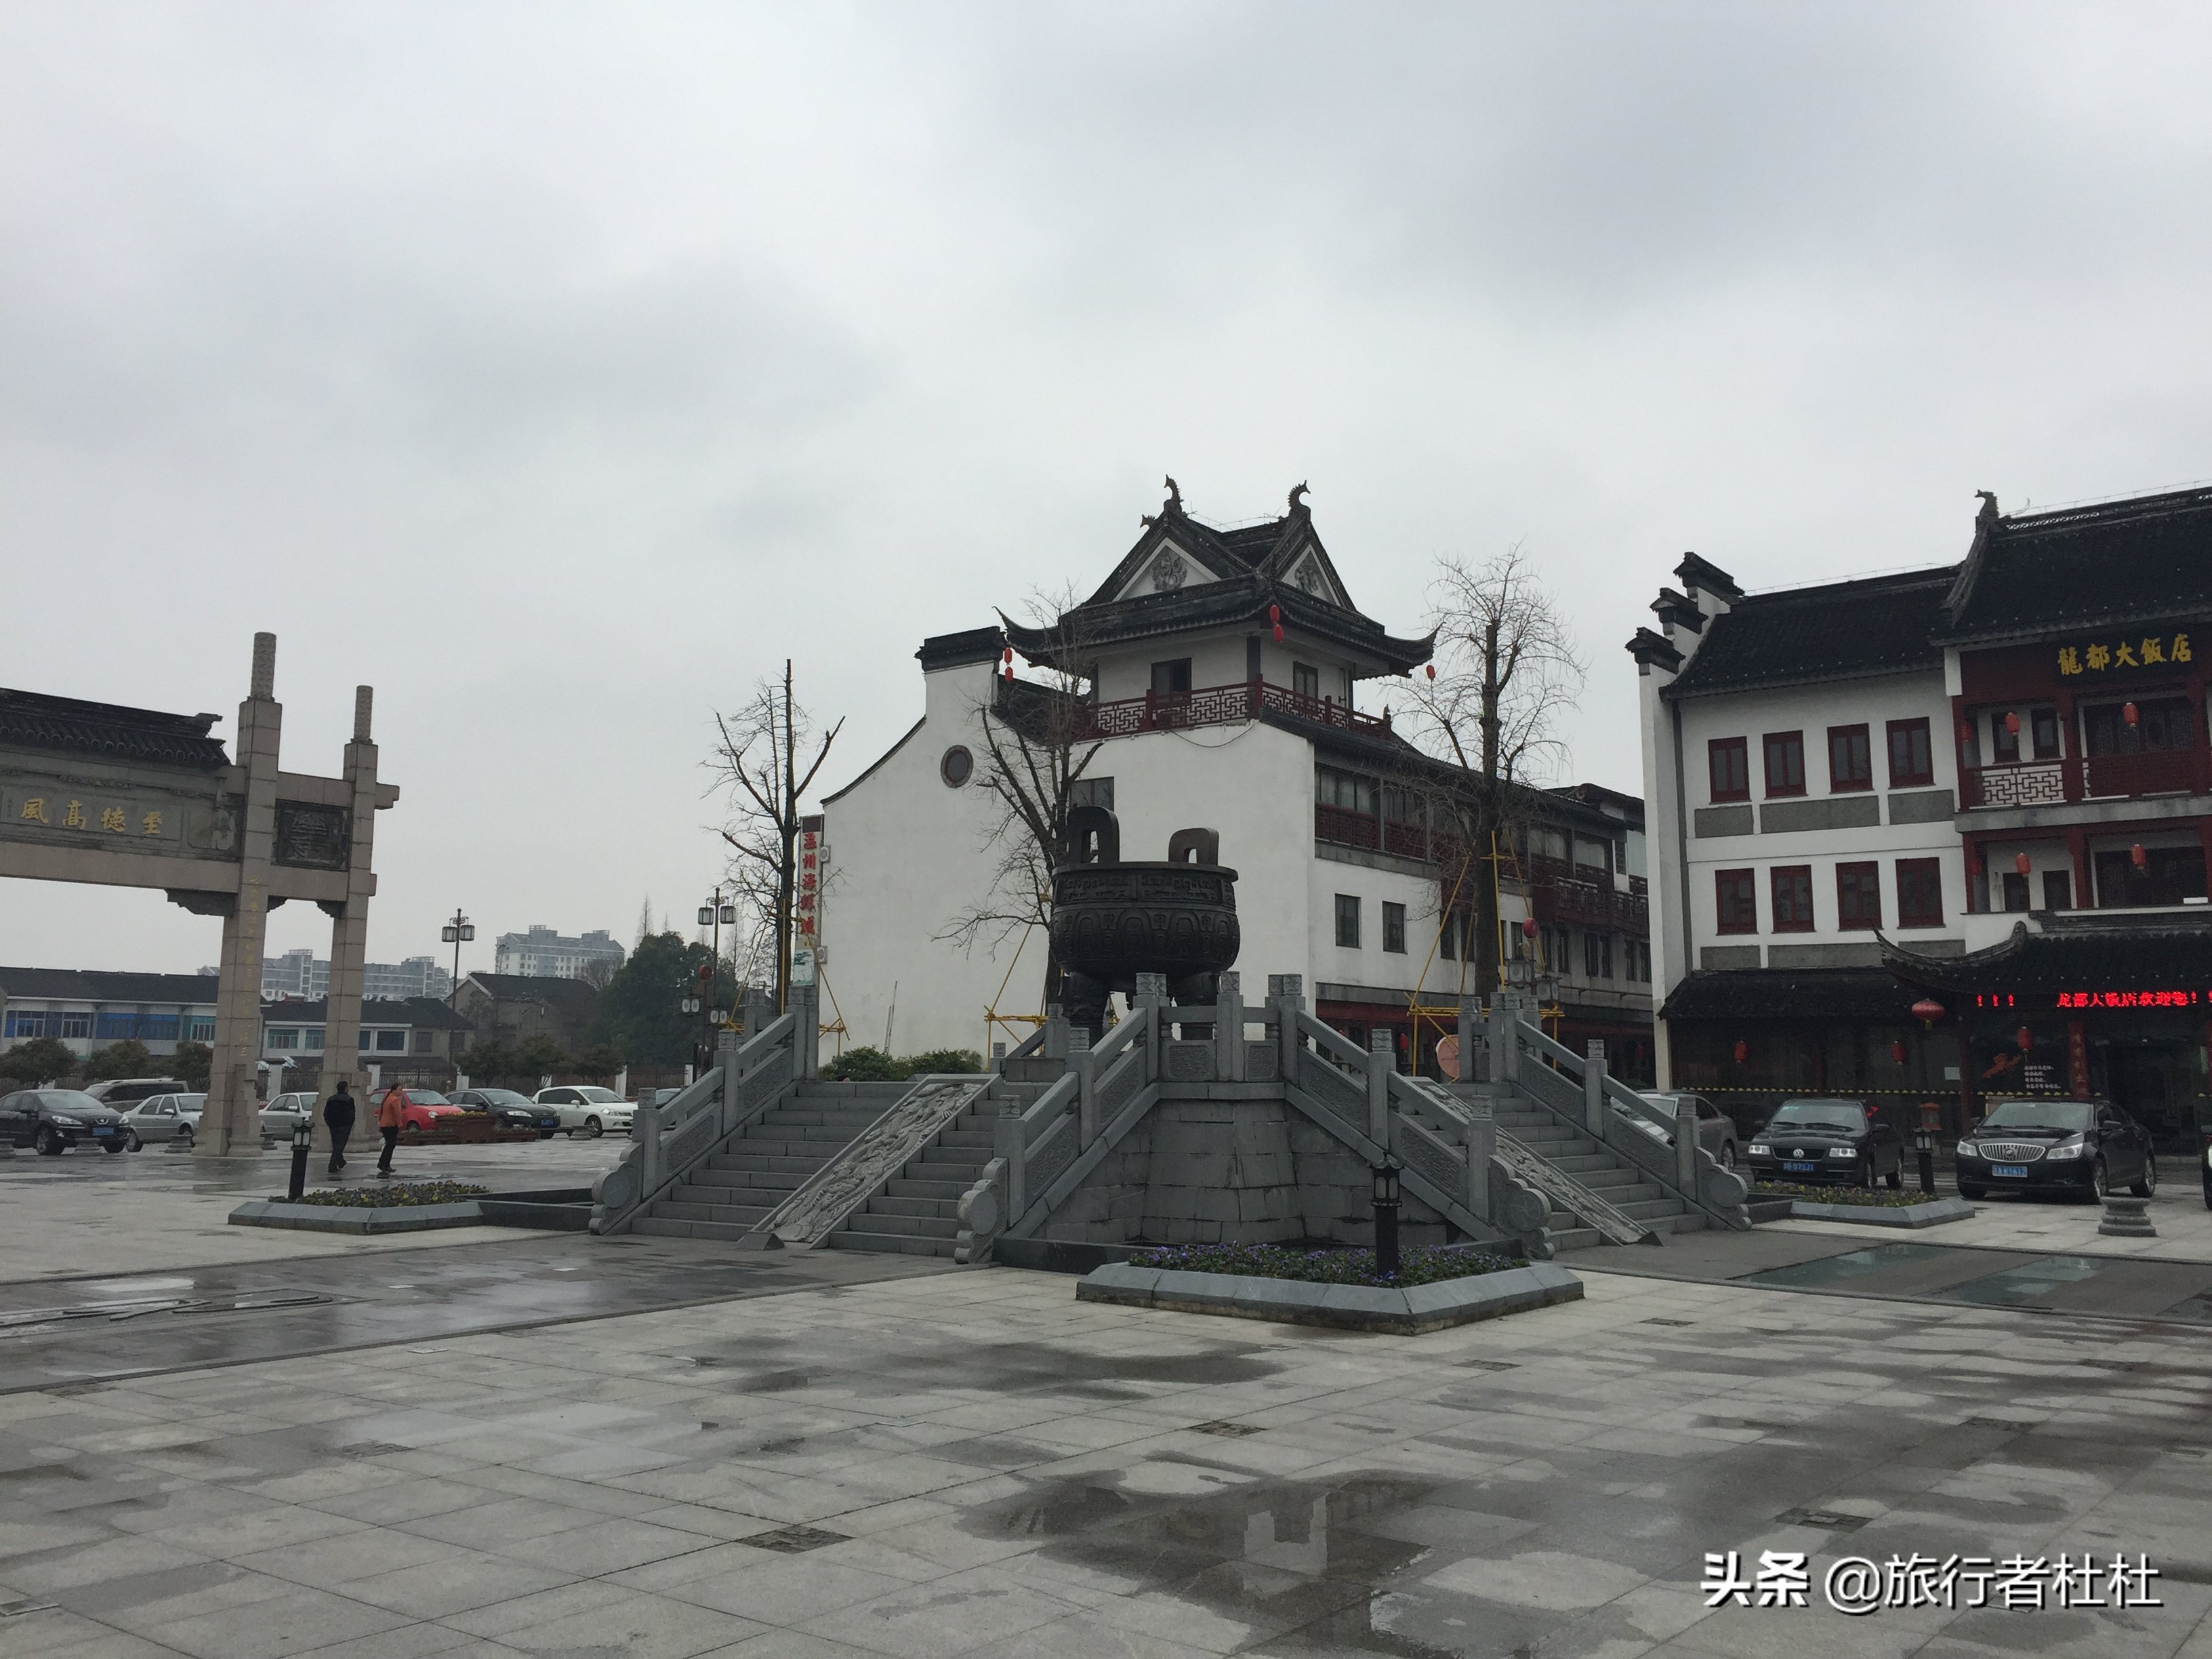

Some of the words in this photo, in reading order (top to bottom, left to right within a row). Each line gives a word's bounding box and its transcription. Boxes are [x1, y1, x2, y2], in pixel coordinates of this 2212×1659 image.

[2057, 633, 2192, 675] 龍都大飯店
